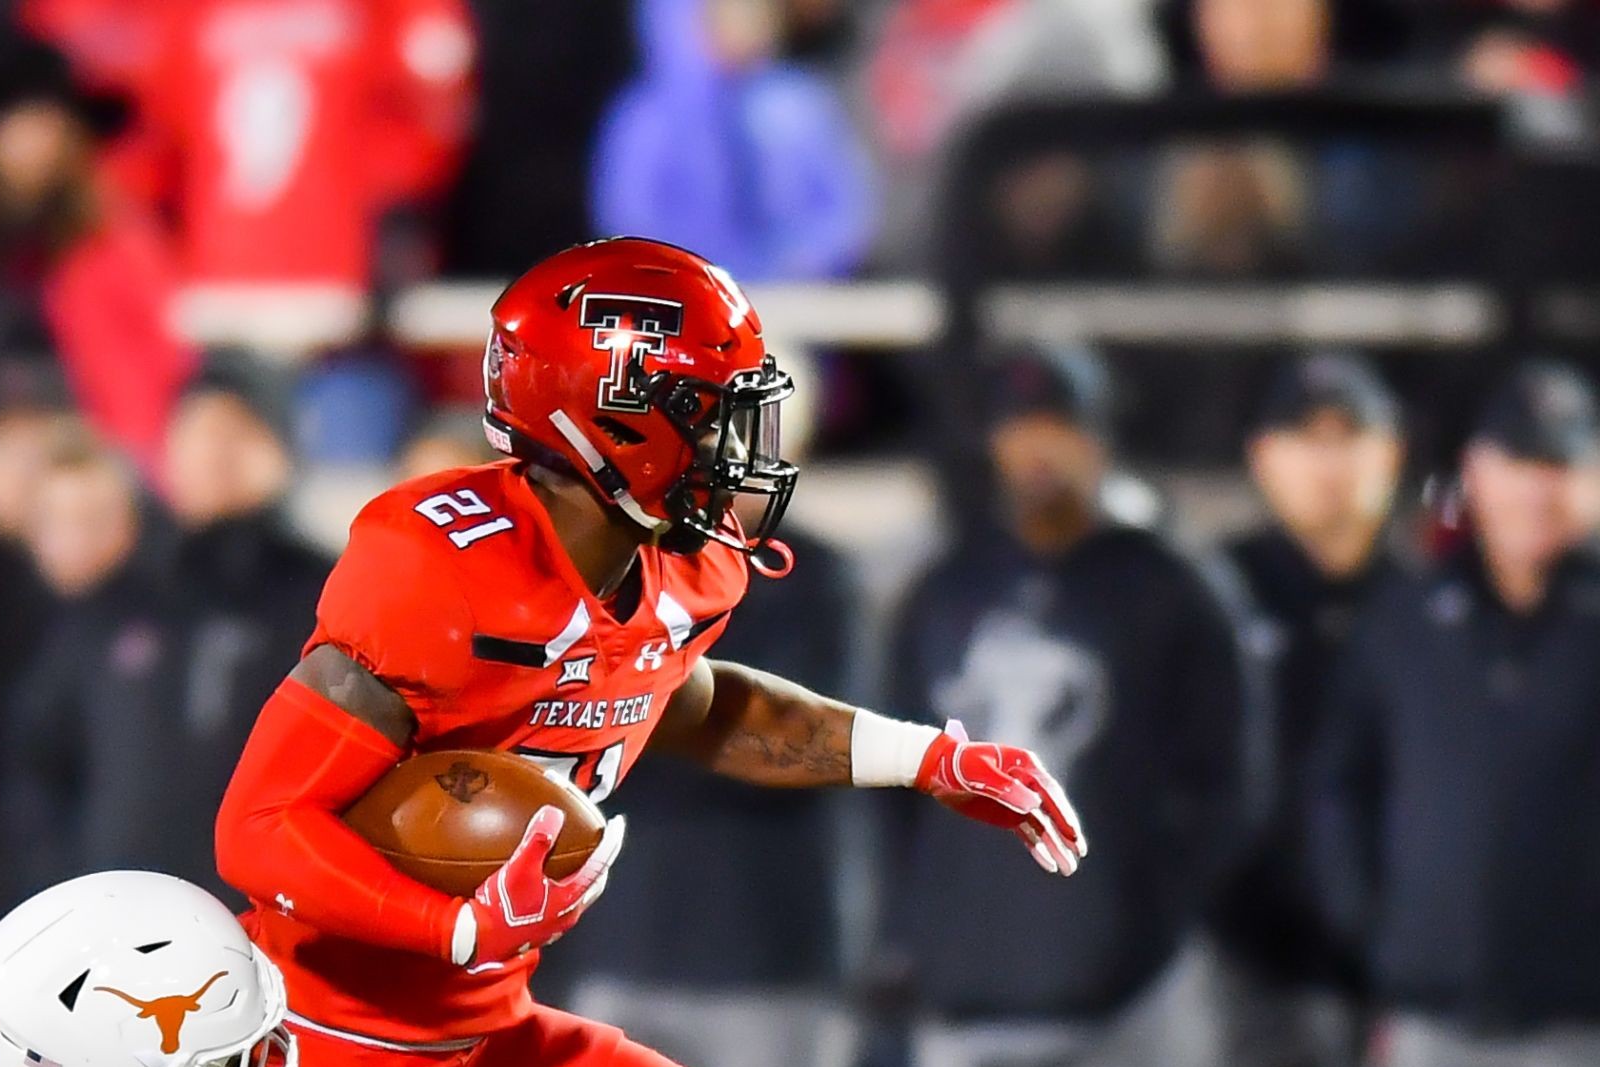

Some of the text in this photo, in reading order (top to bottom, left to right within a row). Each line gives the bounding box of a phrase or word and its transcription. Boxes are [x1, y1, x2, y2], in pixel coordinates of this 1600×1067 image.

[413, 488, 514, 549] 21
[530, 693, 653, 728] TEXAS TECH
